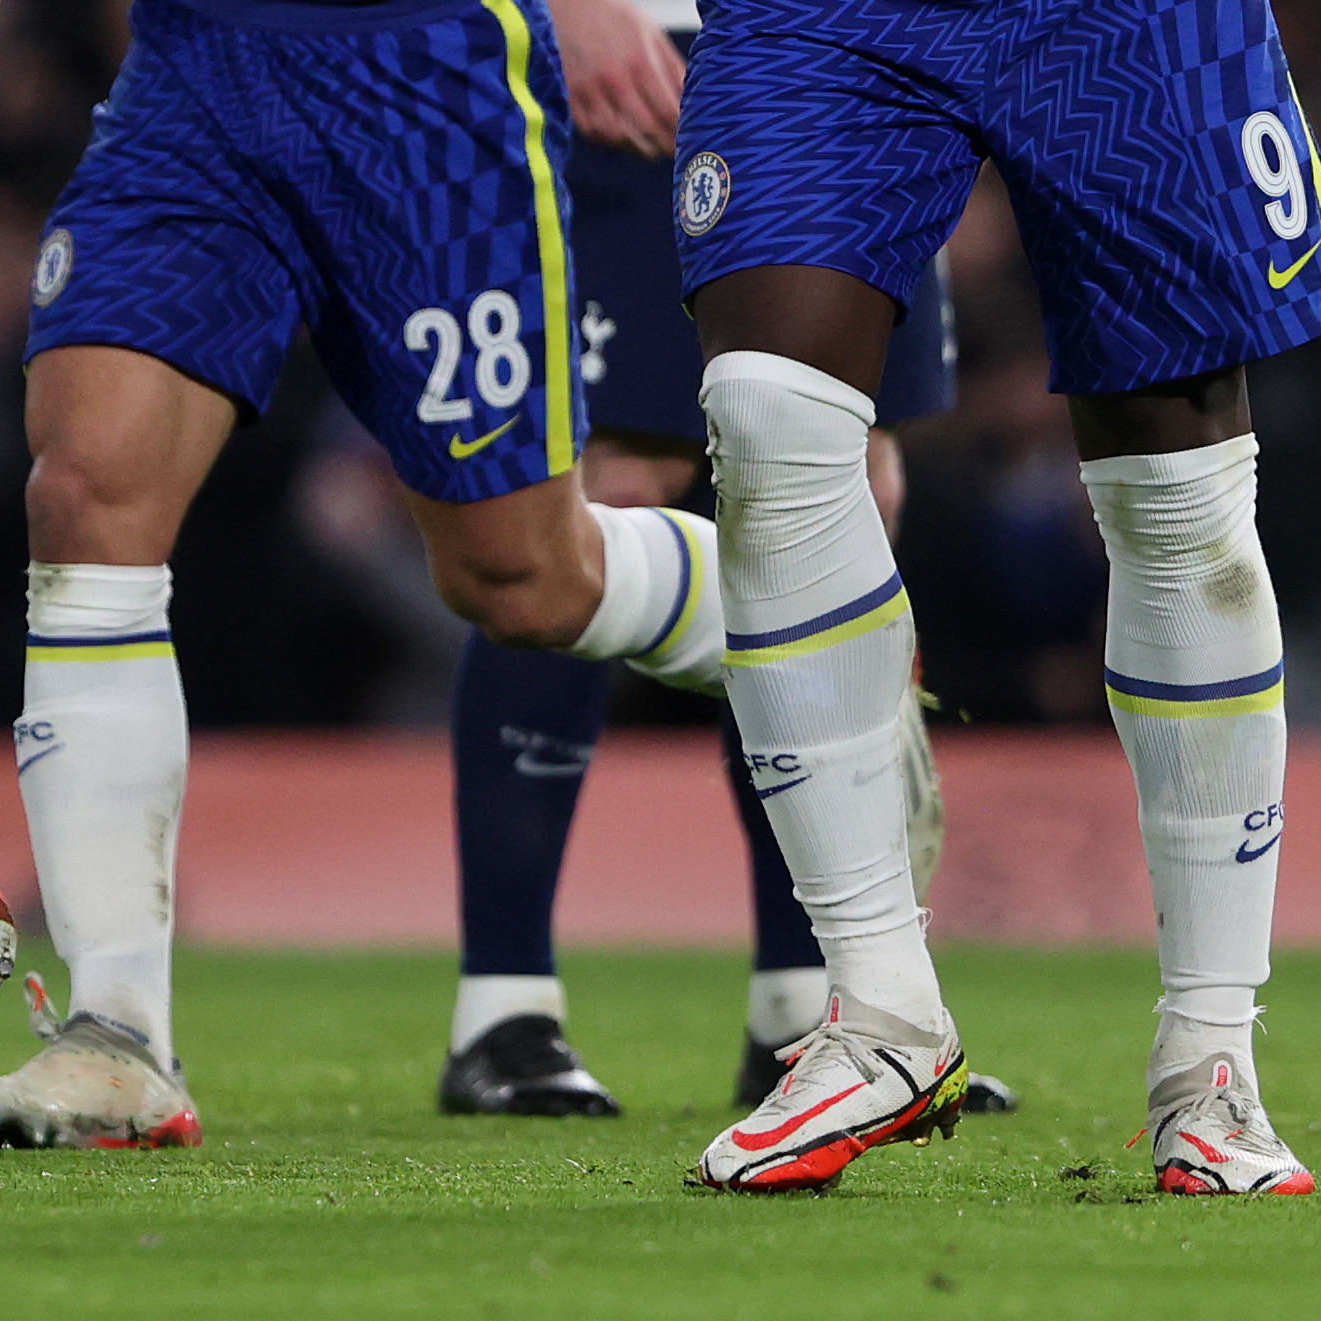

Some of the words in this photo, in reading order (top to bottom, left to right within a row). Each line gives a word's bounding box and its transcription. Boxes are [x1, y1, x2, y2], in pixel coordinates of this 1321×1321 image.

[1241, 110, 1308, 240] 9
[403, 288, 531, 424] 28
[13, 722, 55, 744] FC
